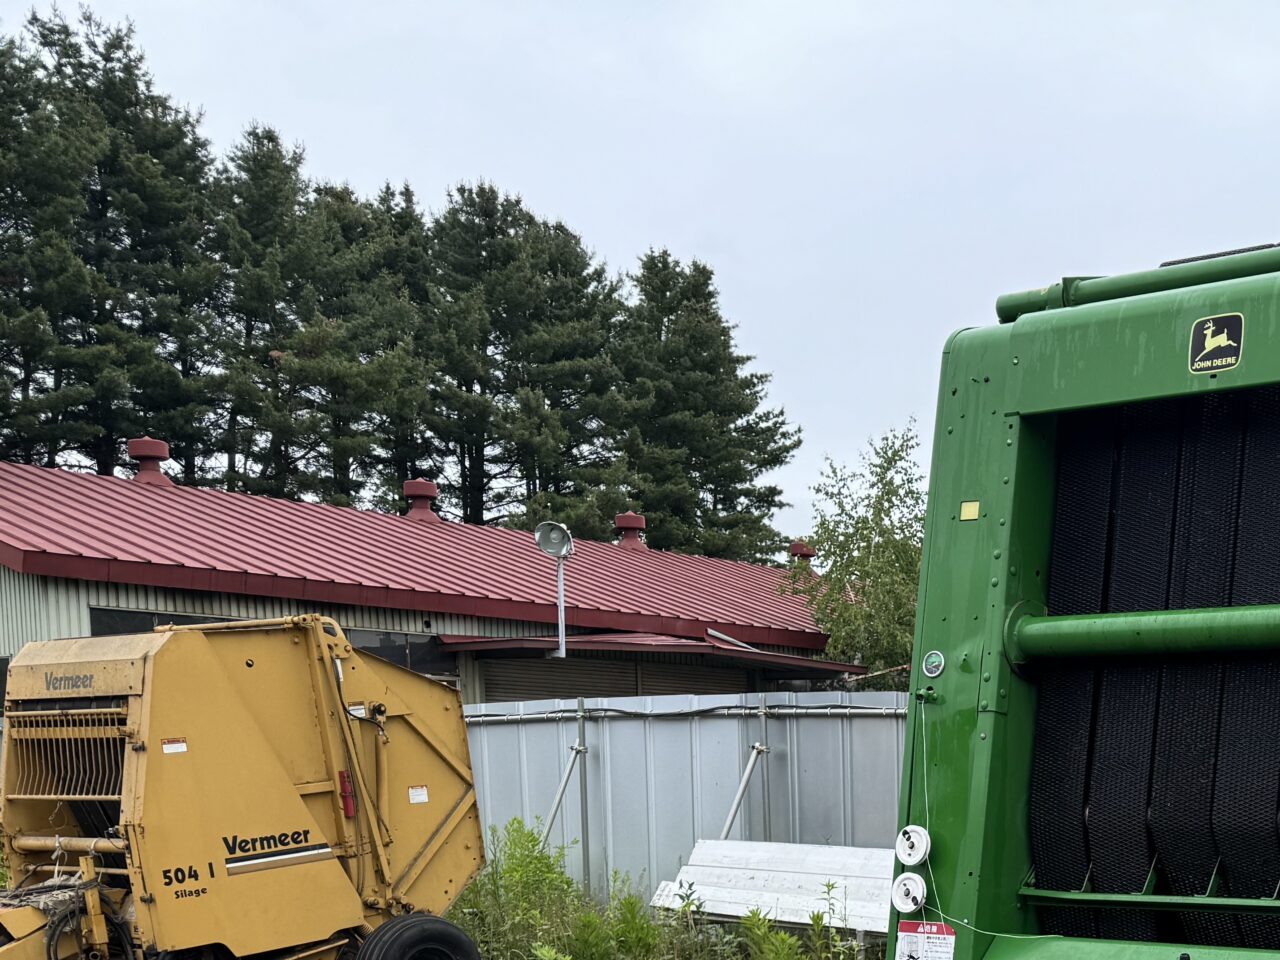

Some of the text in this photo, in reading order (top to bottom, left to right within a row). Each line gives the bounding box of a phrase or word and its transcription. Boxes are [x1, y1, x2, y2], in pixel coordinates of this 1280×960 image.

[1192, 356, 1237, 370] JOHN DEERE
[44, 671, 94, 691] Vermeer
[222, 829, 310, 855] Vermeer
[162, 865, 199, 887] 504
[174, 887, 208, 899] Silage
